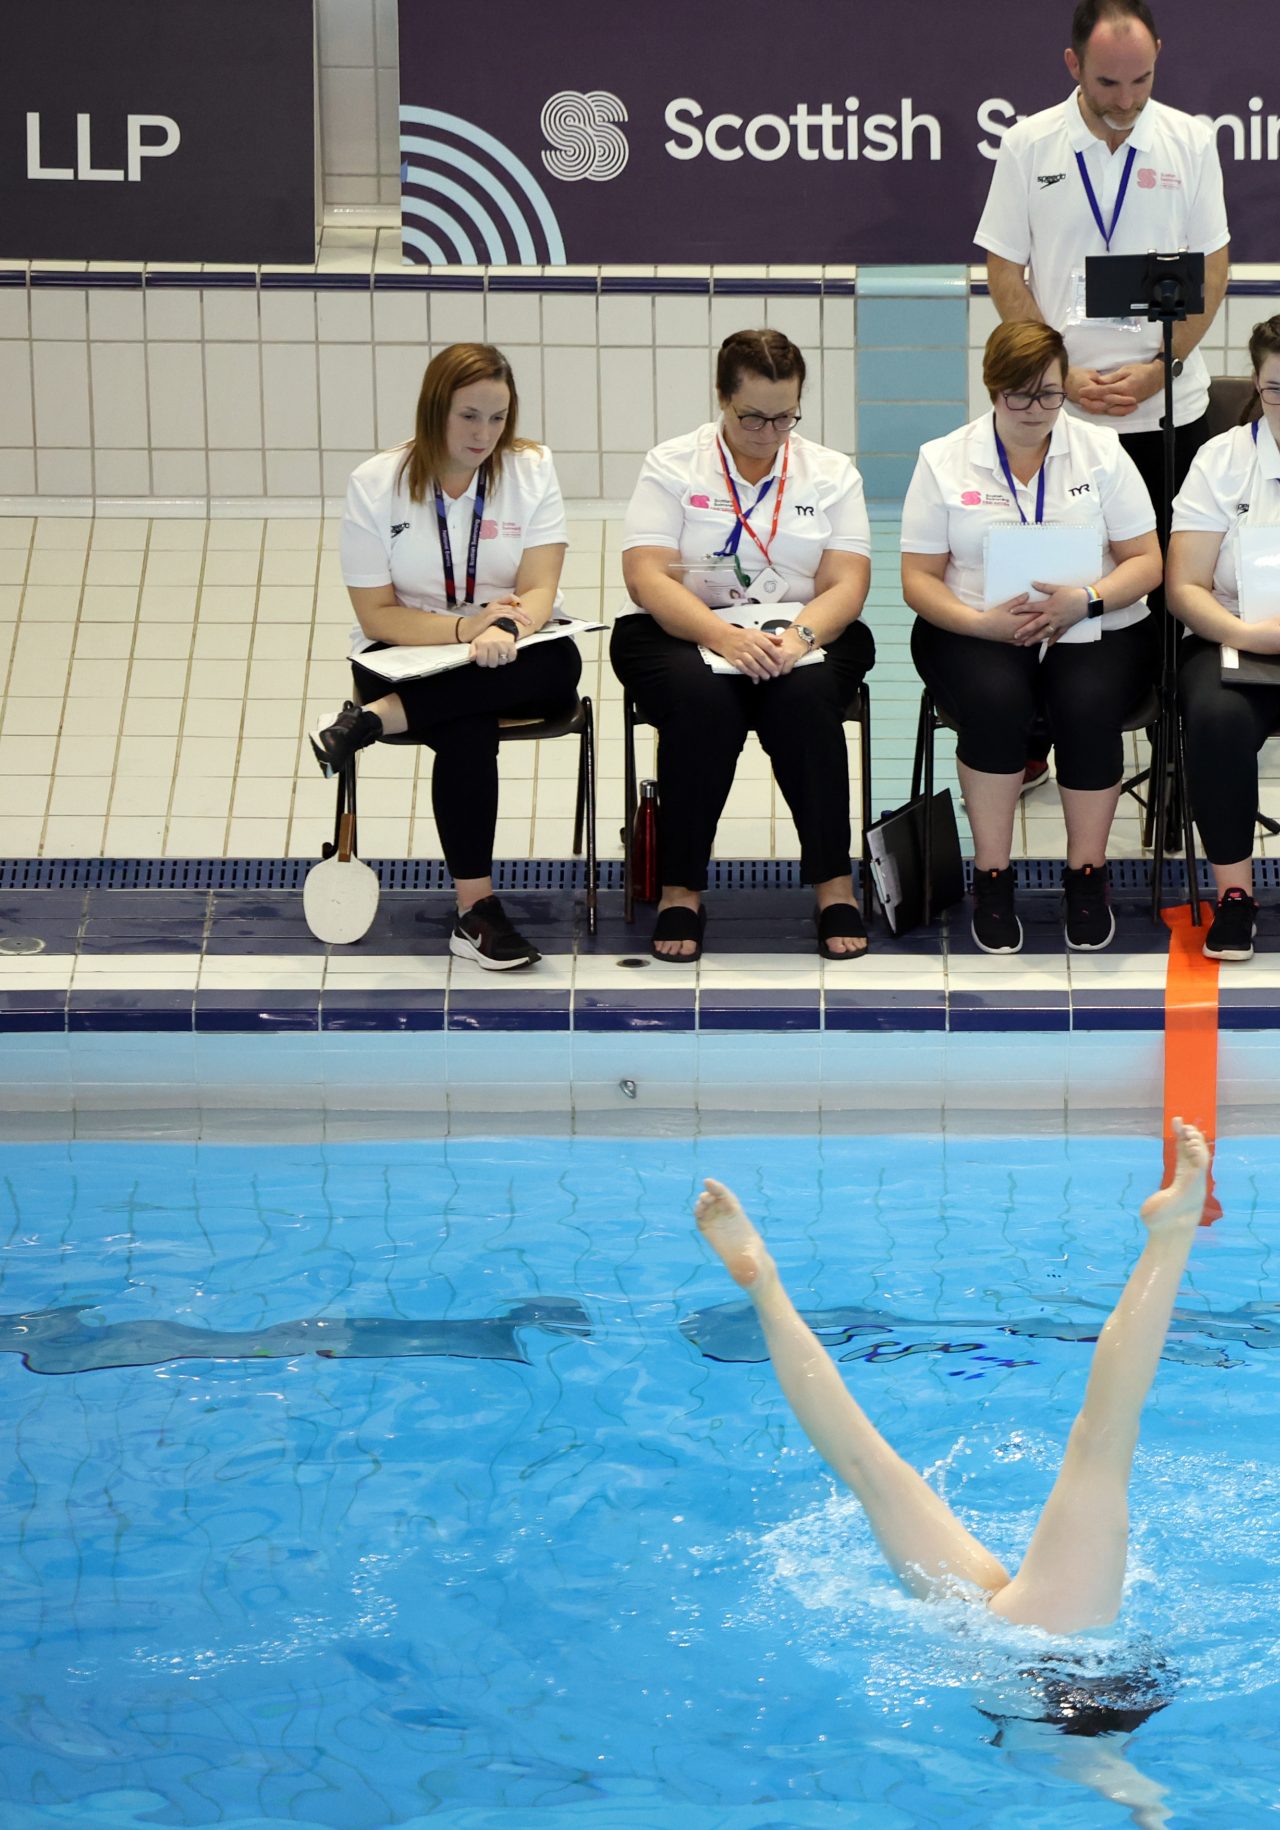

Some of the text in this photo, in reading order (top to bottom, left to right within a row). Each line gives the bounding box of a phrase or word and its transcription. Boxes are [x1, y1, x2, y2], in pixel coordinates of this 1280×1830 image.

[27, 113, 181, 182] LLP
[664, 97, 942, 161] Scottish
[1068, 483, 1091, 497] TYR
[795, 505, 815, 517] TYR
